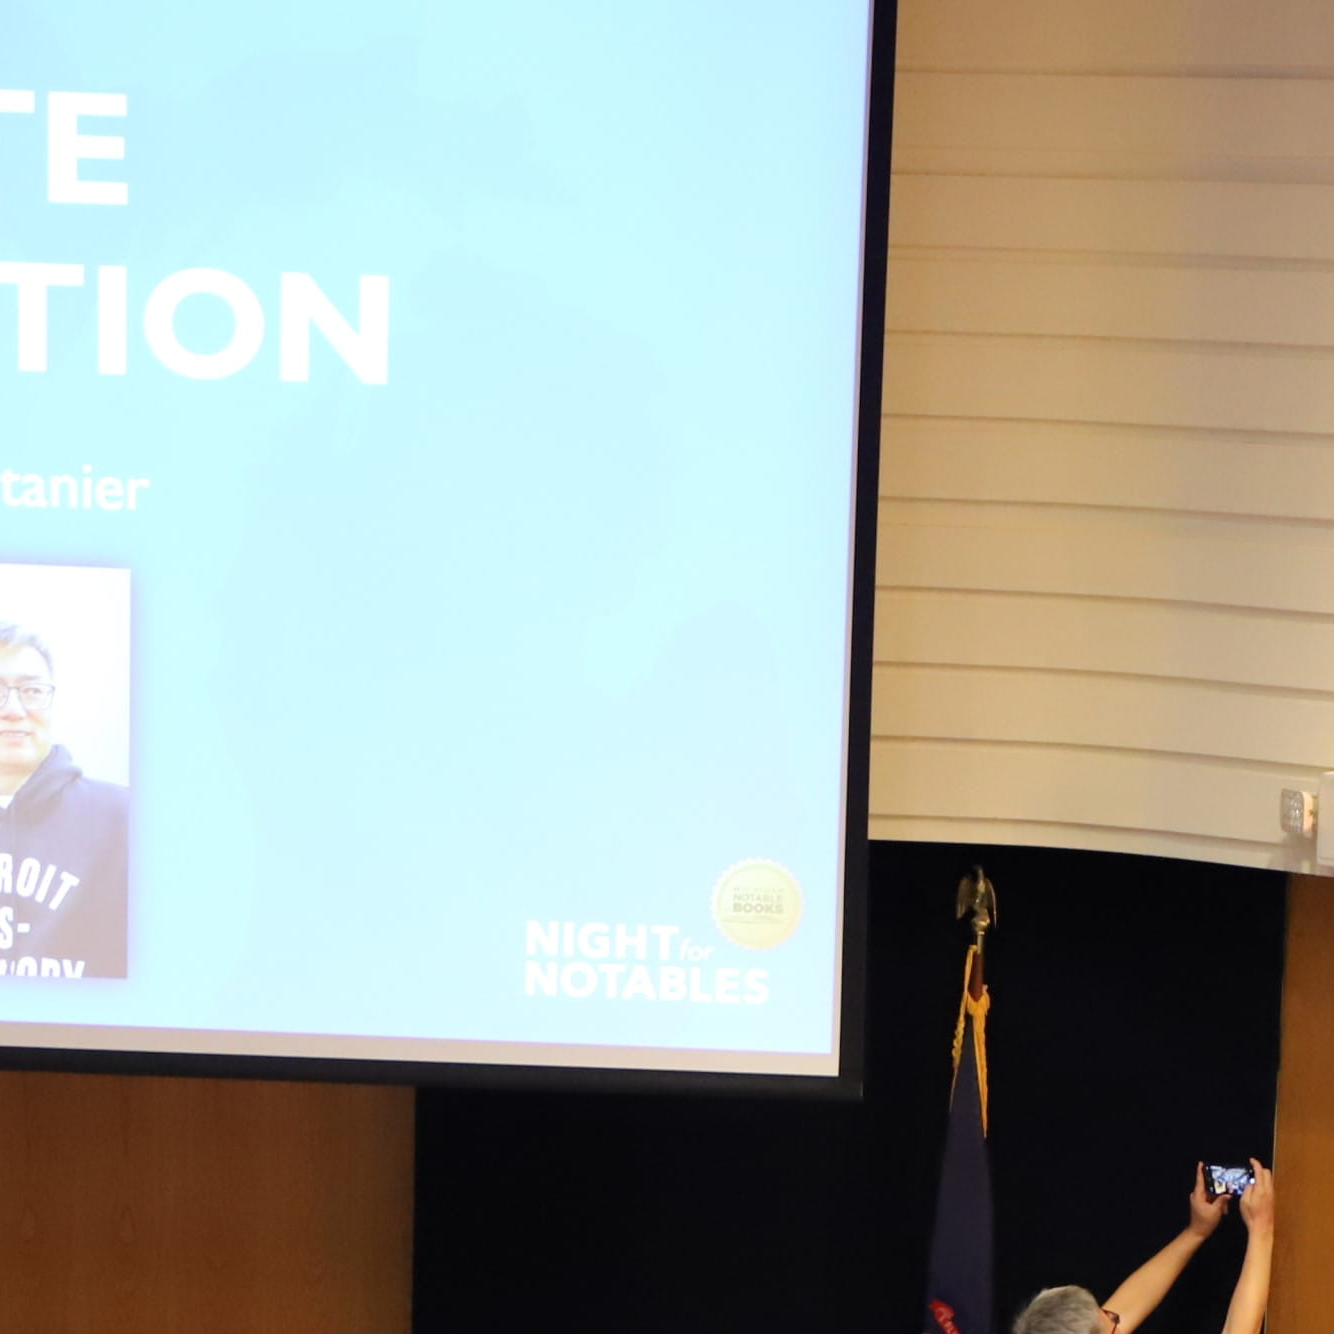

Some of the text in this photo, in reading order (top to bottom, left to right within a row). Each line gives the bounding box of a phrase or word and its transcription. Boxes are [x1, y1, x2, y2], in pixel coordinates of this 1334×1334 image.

[525, 919, 715, 962] NIGHT for
[524, 959, 770, 1005] NOTABLES
